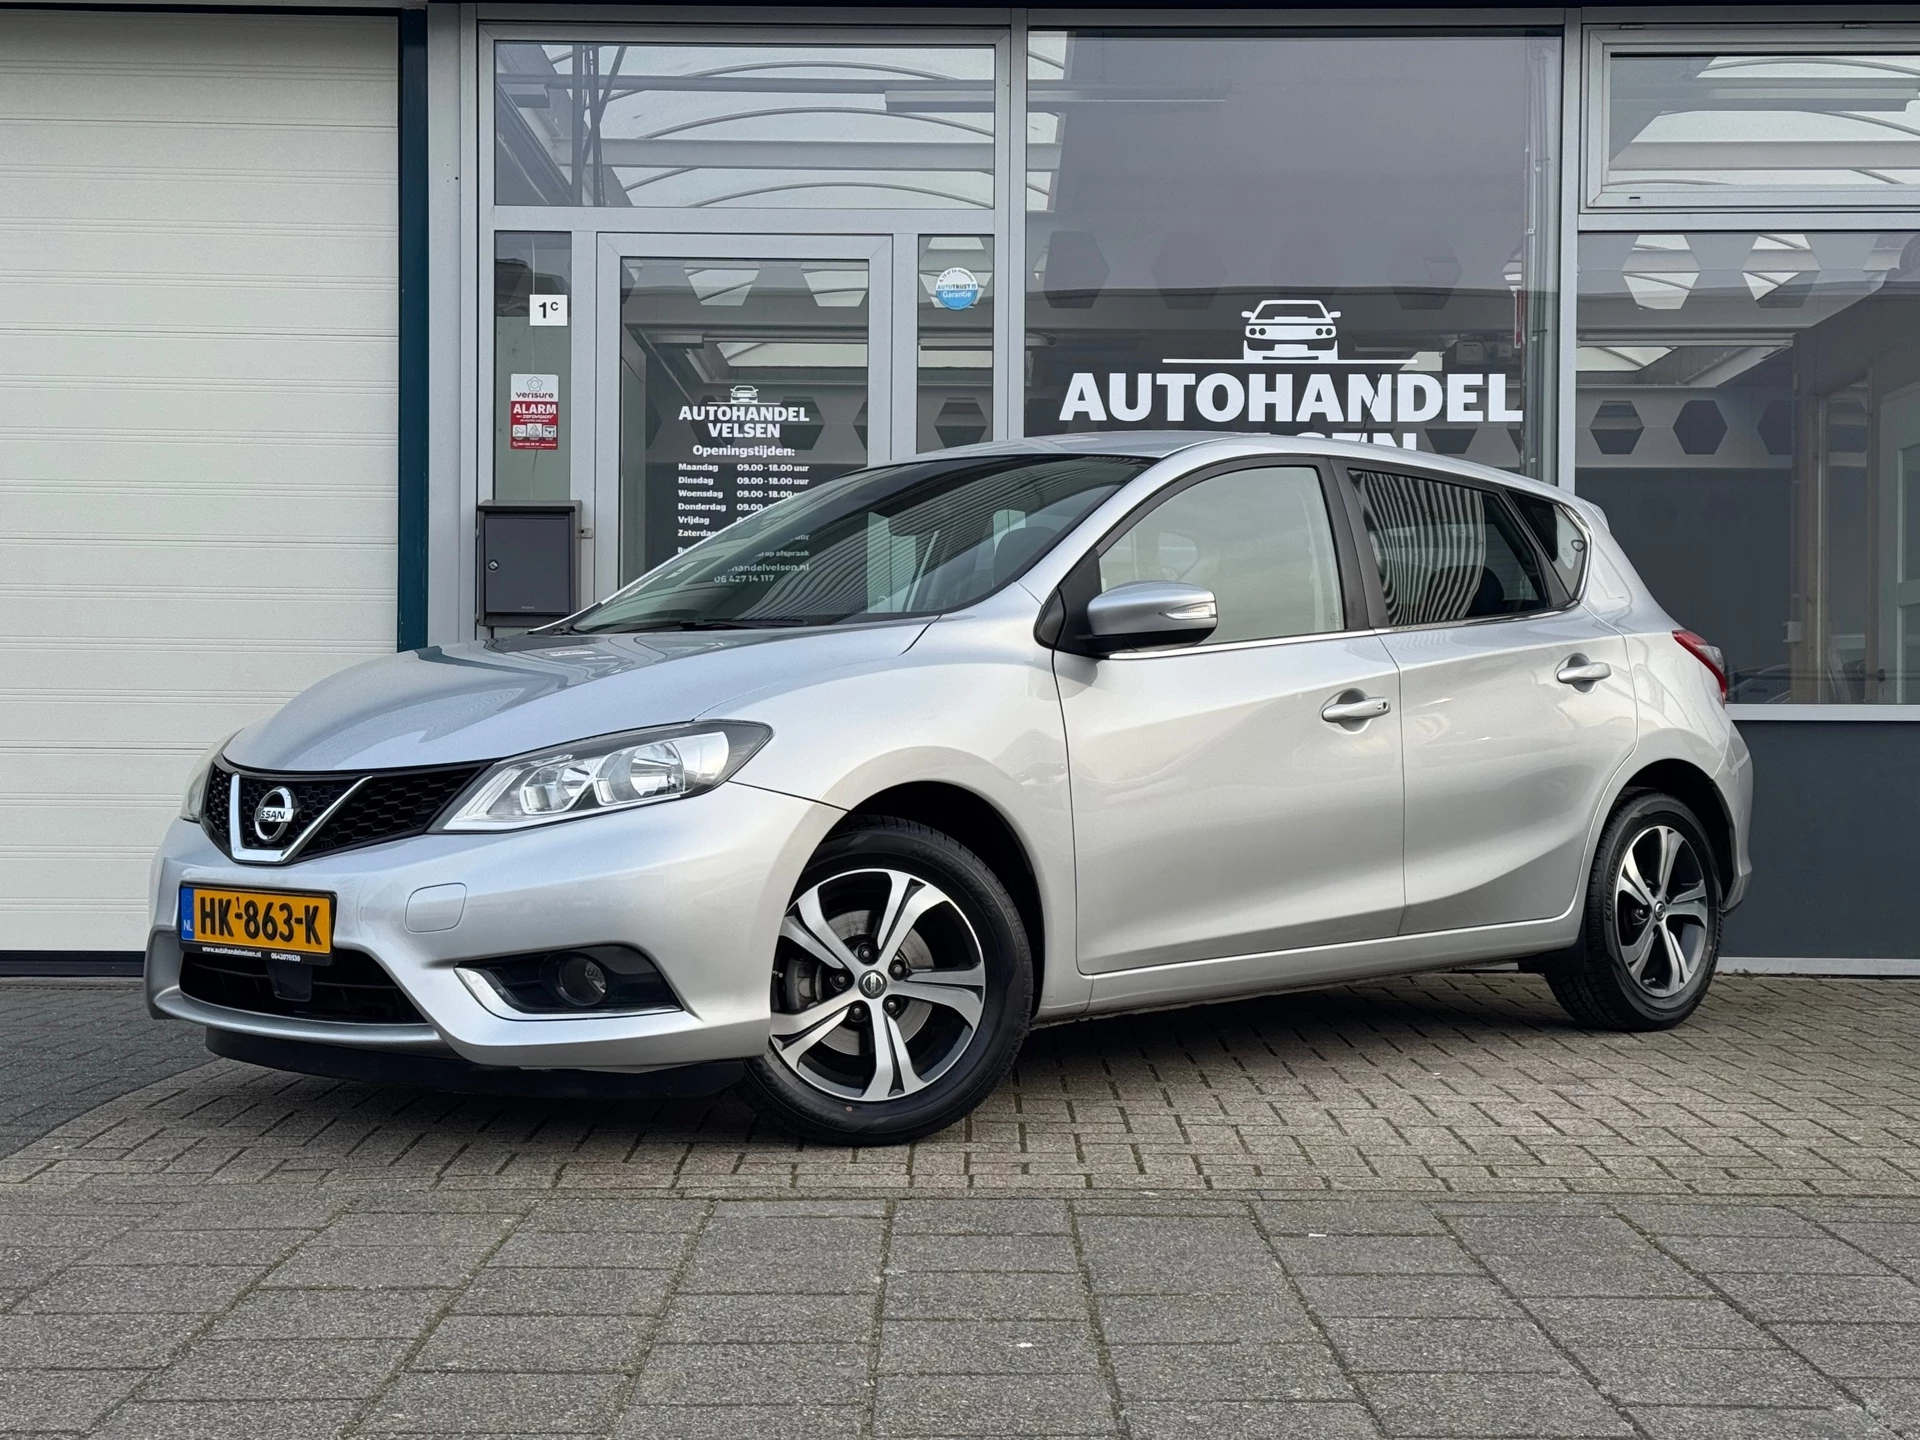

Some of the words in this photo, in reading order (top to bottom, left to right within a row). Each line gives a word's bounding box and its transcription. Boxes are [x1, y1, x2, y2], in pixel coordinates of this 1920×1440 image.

[515, 391, 554, 399] verisure
[1058, 372, 1523, 423] AUTOHANDEL
[512, 403, 557, 414] ALARM
[678, 406, 810, 421] AUTOHANDEL
[708, 423, 780, 438] VELSEN
[692, 444, 796, 458] Openingstijden:
[678, 463, 719, 472] Maandag
[678, 476, 714, 486] Dinsdag
[678, 490, 723, 499] Woensdag
[678, 502, 726, 512] Donderdag
[678, 516, 710, 525] Vrijdag
[714, 575, 727, 583] 06
[760, 574, 775, 582] 117
[257, 810, 286, 820] SSAN
[183, 919, 193, 931] NL
[199, 897, 323, 945] HK-863-K
